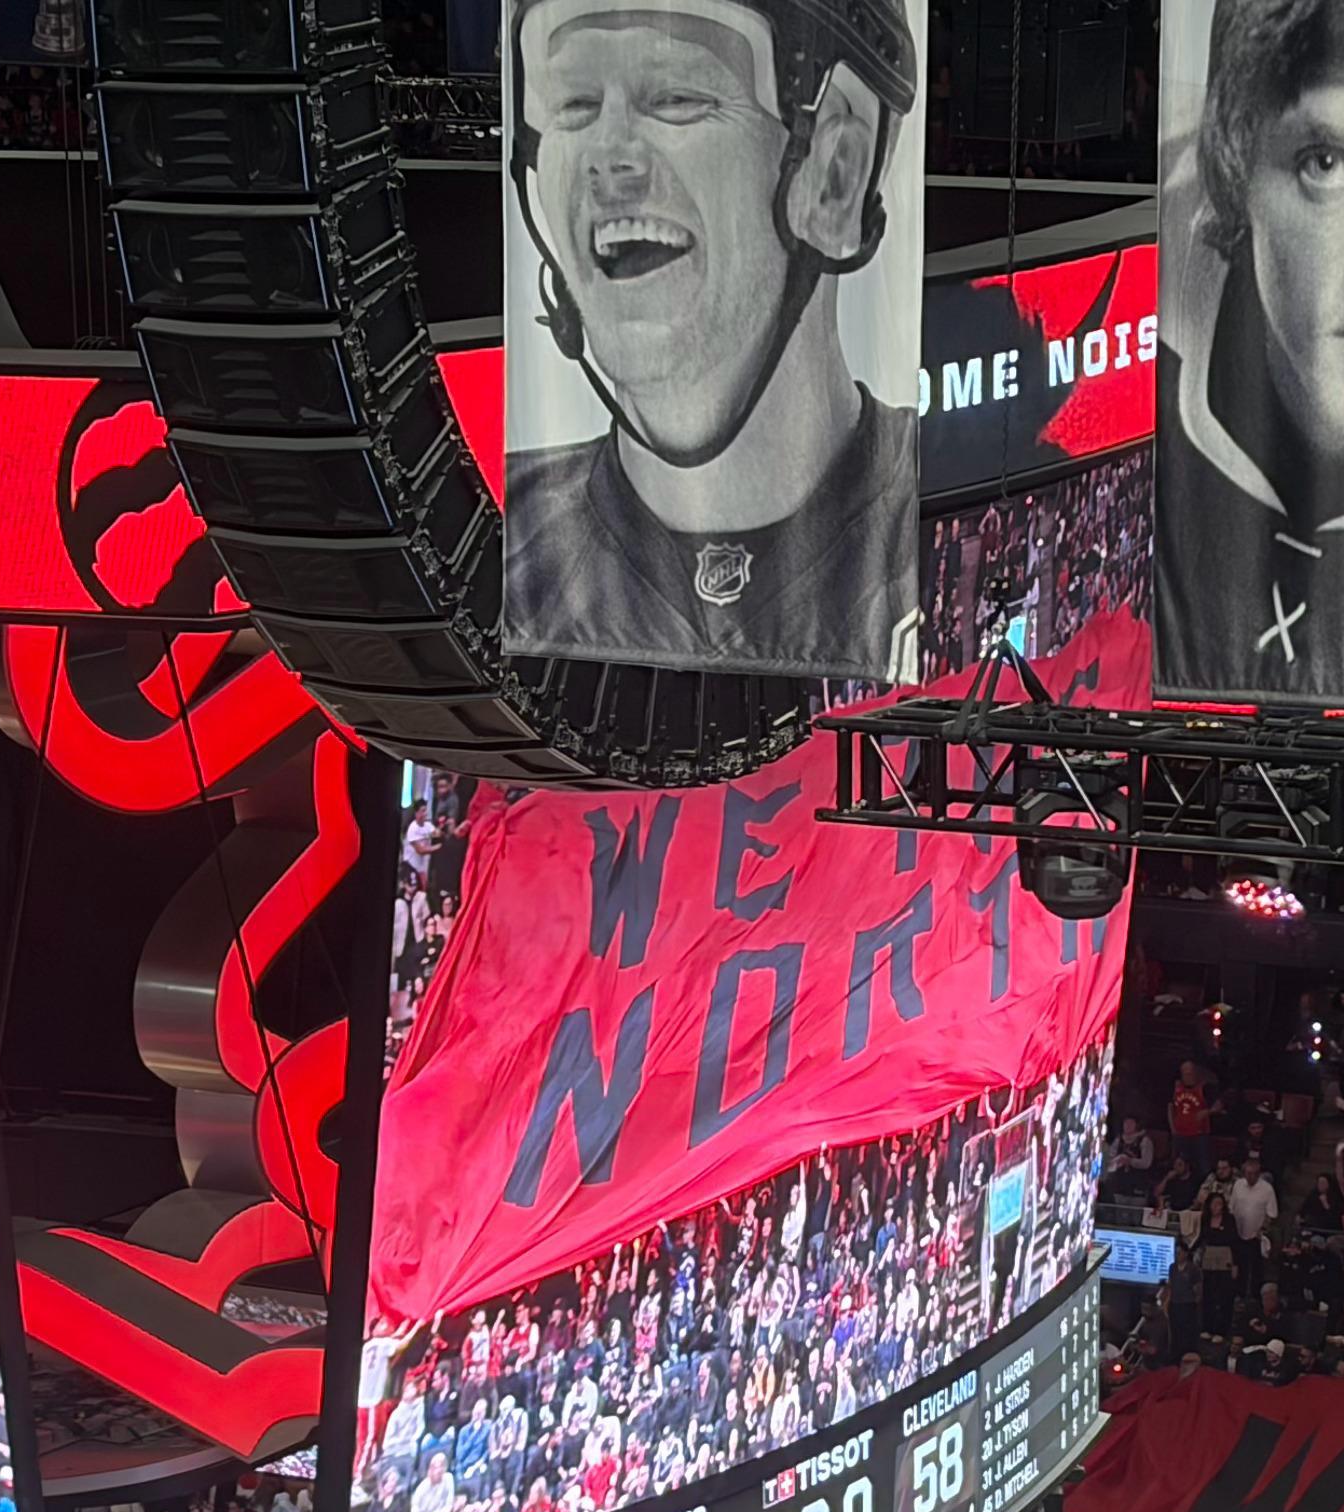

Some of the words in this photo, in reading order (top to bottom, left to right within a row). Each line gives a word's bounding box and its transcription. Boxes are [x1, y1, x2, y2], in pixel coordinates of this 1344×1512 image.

[583, 781, 803, 970] WE
[903, 1370, 977, 1437] CLEVELAND
[796, 1429, 874, 1491] TISSOT
